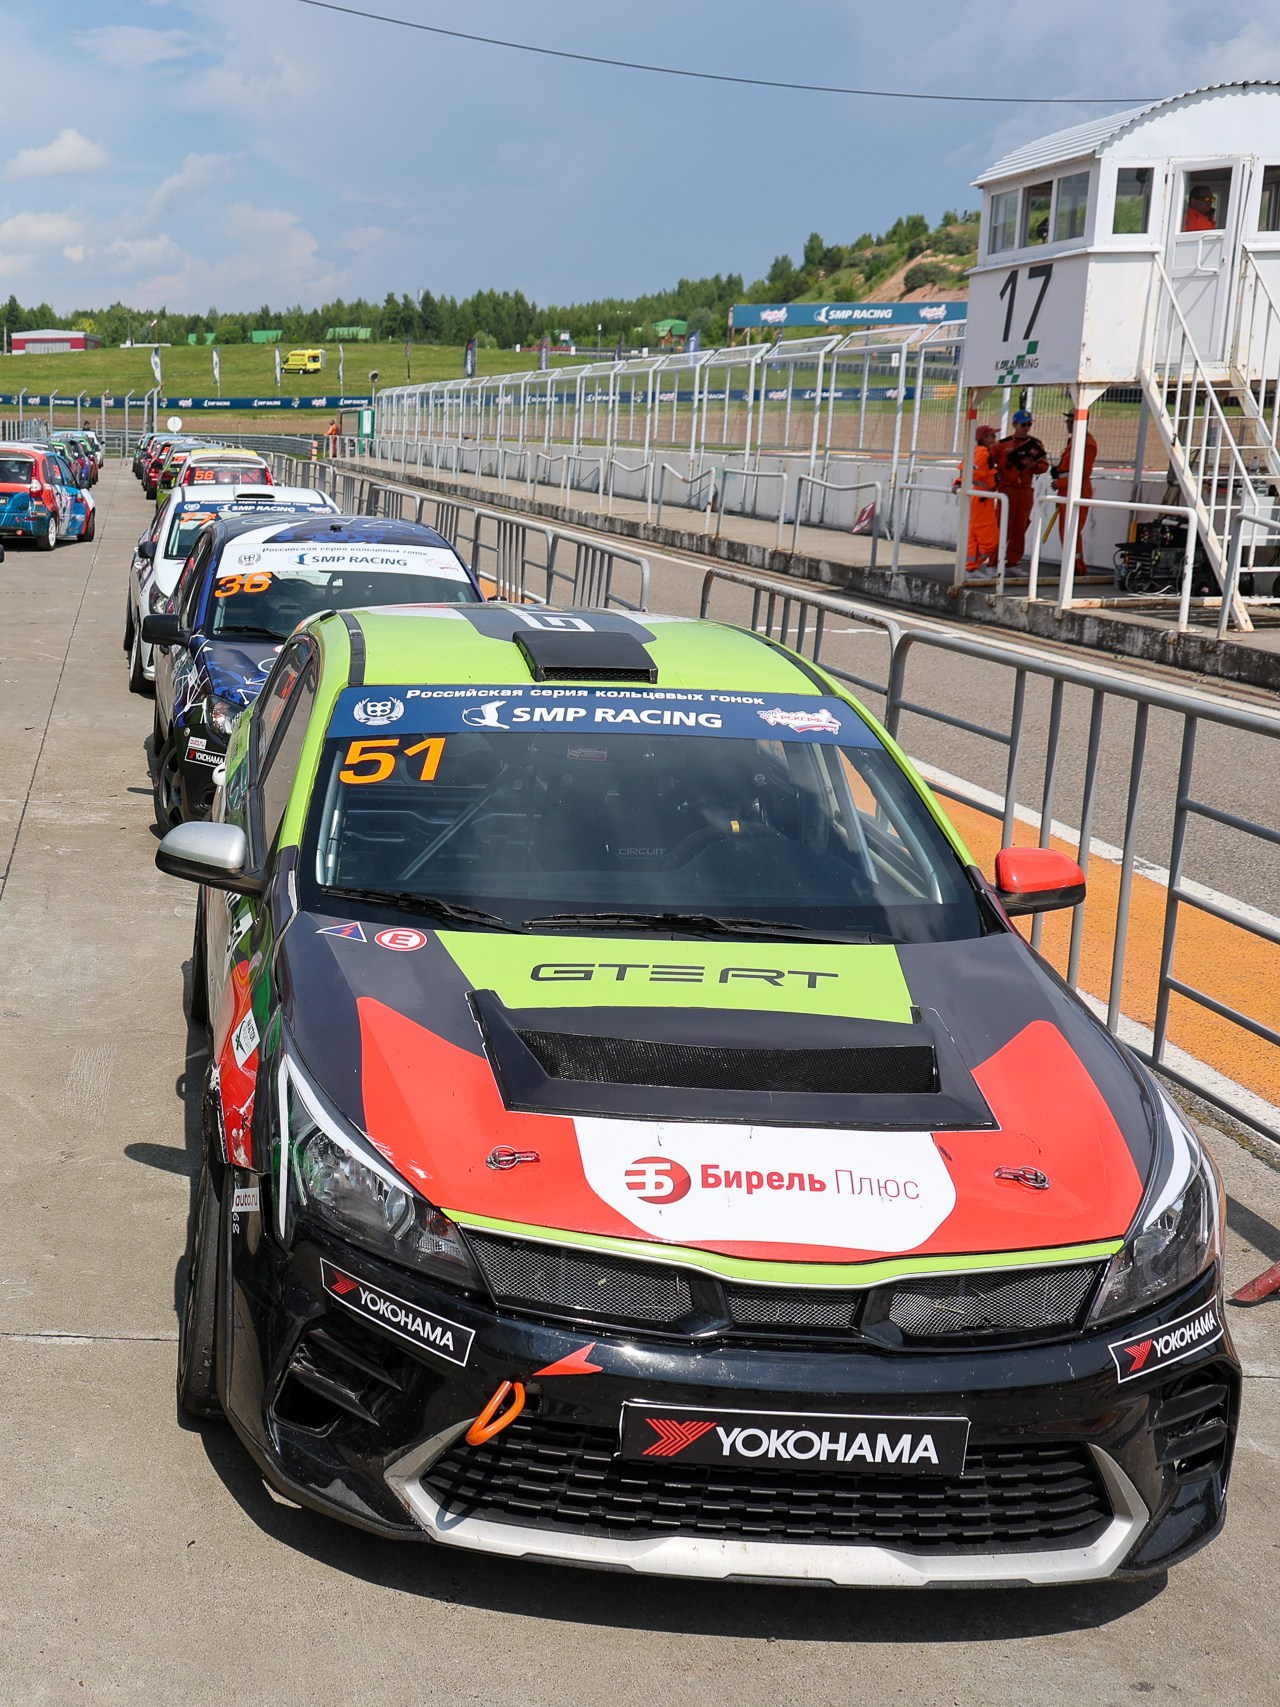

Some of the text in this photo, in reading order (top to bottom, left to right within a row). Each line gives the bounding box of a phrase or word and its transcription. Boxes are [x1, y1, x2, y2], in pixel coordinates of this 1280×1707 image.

[828, 309, 893, 319] SMP RACING
[999, 263, 1054, 343] 17
[194, 470, 215, 480] 56
[256, 505, 296, 513] RACING
[311, 555, 408, 566] SMP RACING
[214, 571, 272, 598] 36
[405, 688, 765, 705] Российская серия кольцевых гонок
[512, 707, 723, 728] SMP RACING
[780, 714, 823, 723] РСКГ.РФ
[339, 737, 446, 785] 51
[530, 963, 839, 989] GTE RT
[700, 1164, 920, 1200] Бирель Плюс
[358, 1286, 454, 1352] YOKOHAMA
[1152, 1309, 1217, 1358] YOKOHAMA
[715, 1426, 939, 1464] YOKOHAMA
